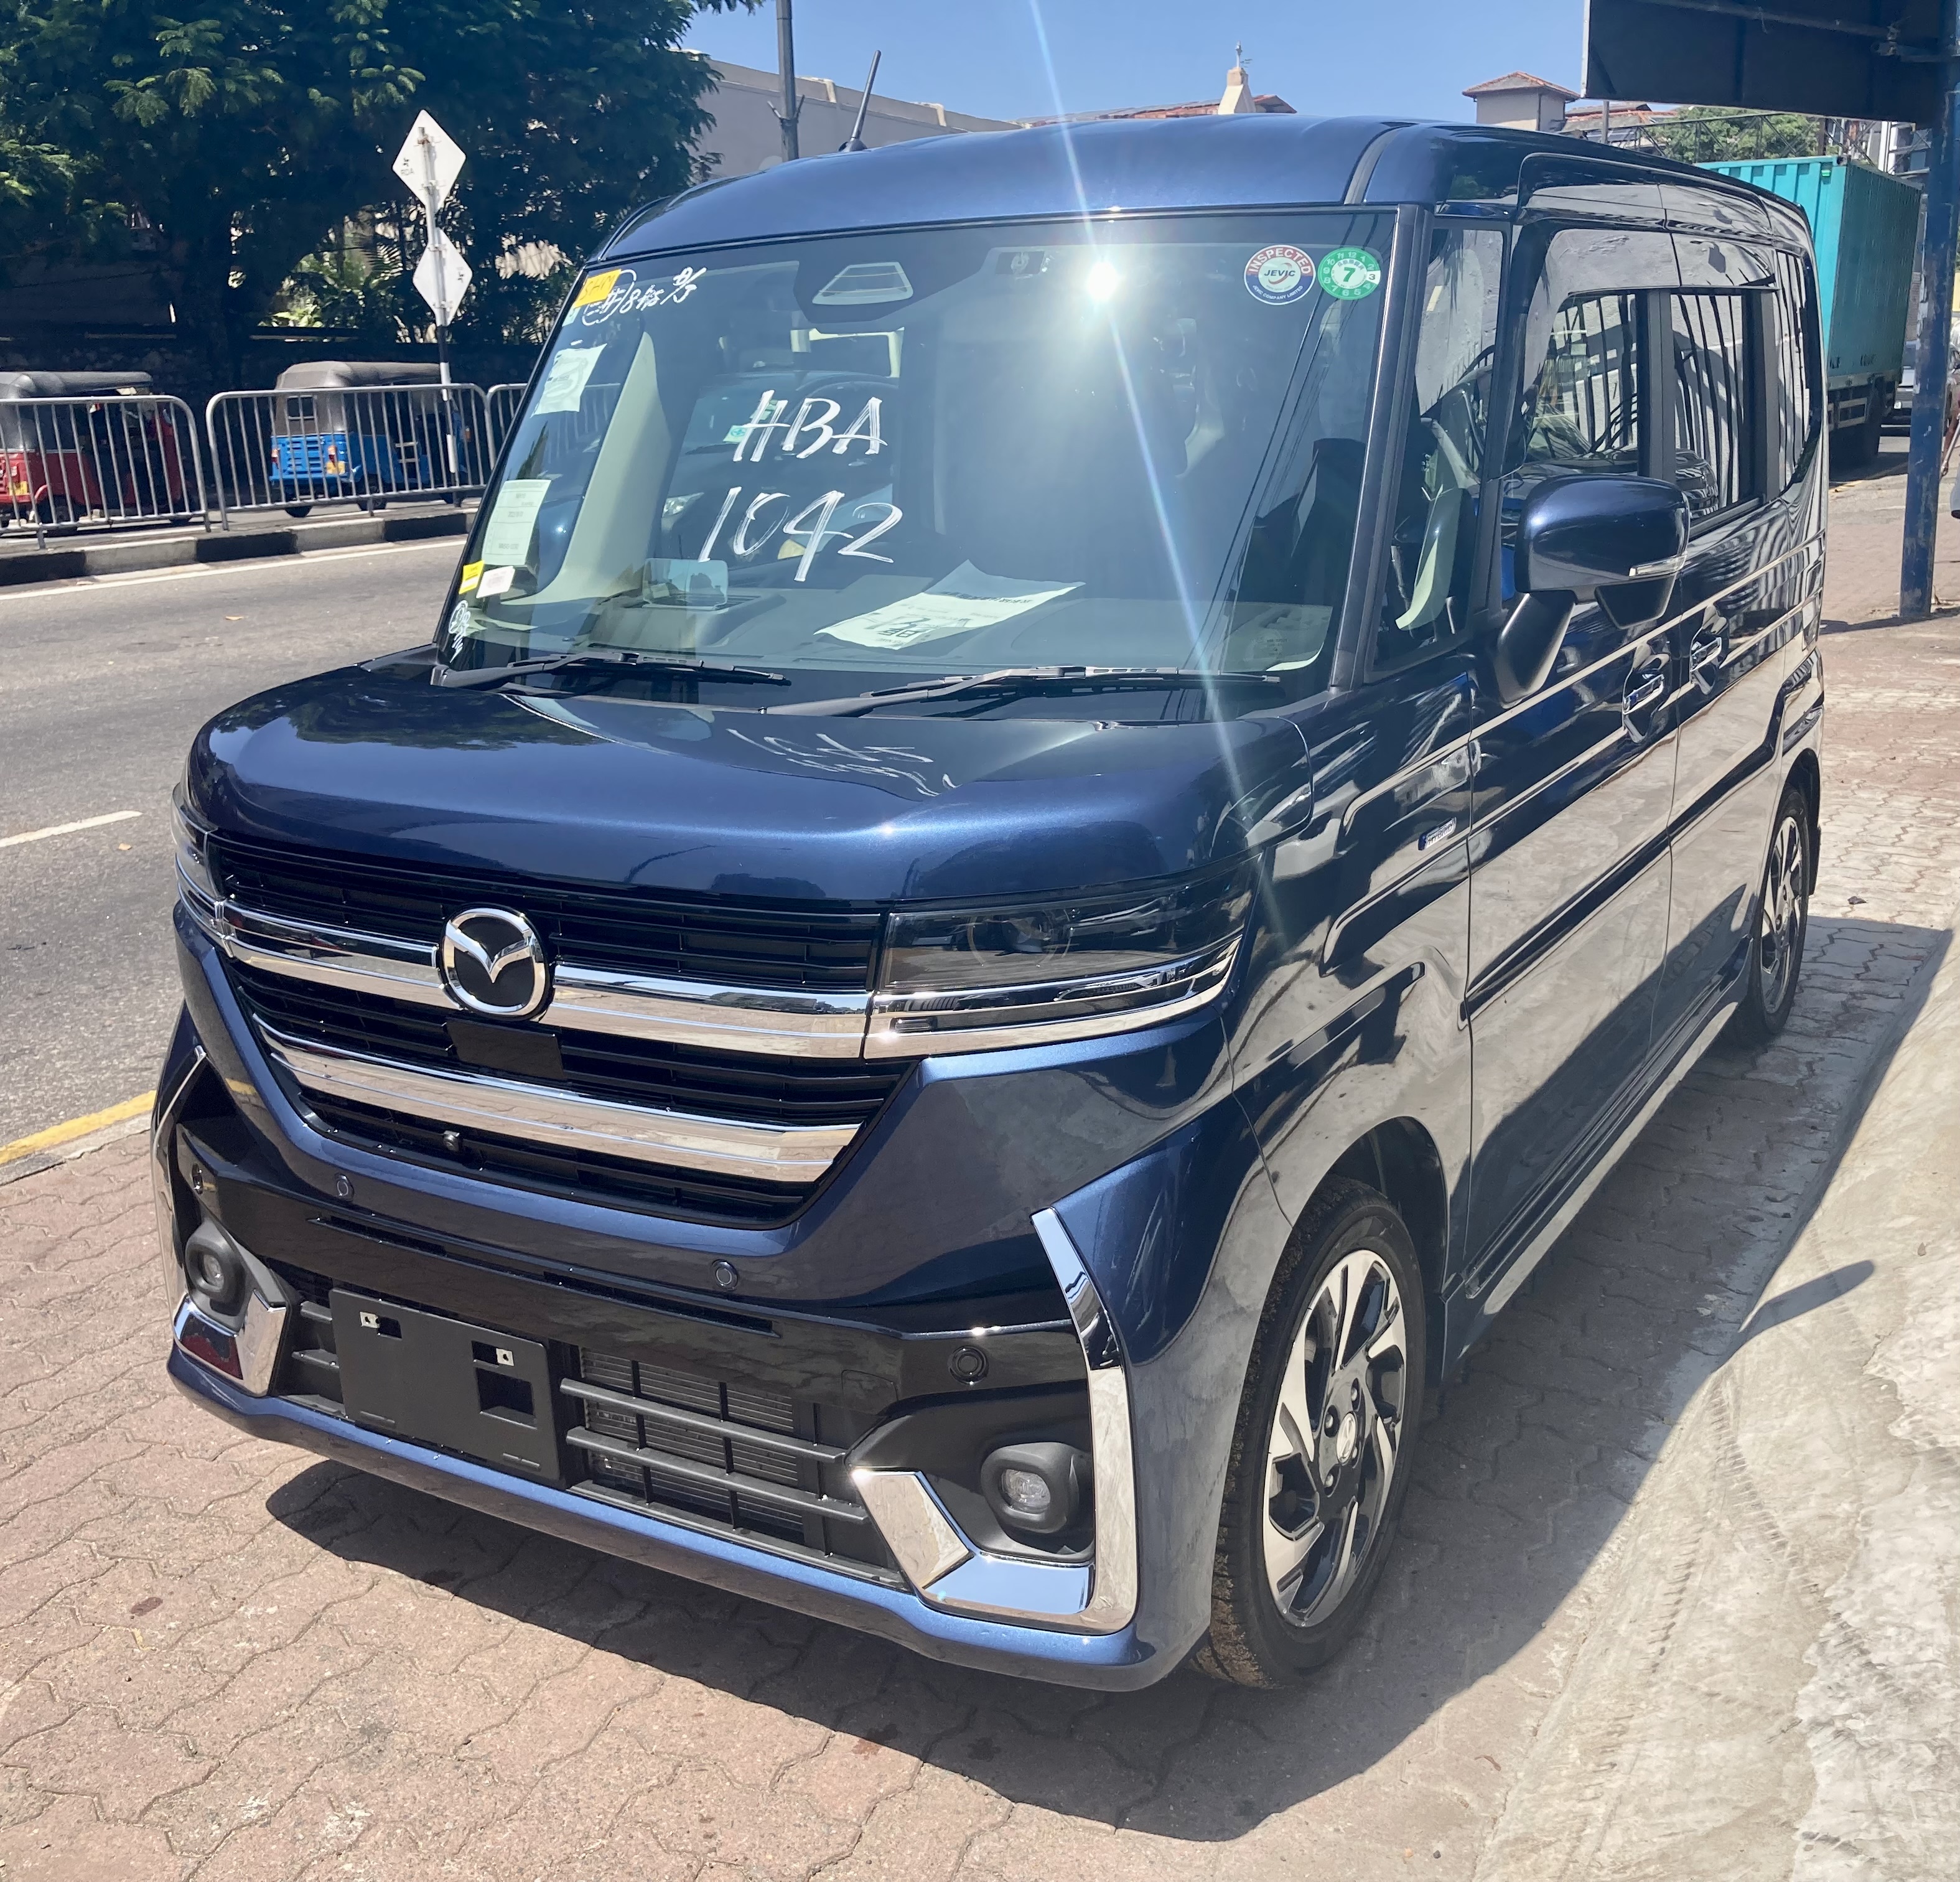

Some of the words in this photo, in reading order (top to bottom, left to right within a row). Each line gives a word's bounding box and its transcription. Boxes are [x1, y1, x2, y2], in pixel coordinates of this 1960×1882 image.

[1248, 248, 1311, 274] INSPECTED
[1343, 267, 1356, 283] 7
[1253, 285, 1264, 295] JEVIC
[1287, 286, 1304, 297] LIMITED
[732, 390, 888, 462] HBA
[698, 486, 903, 582] 1042
